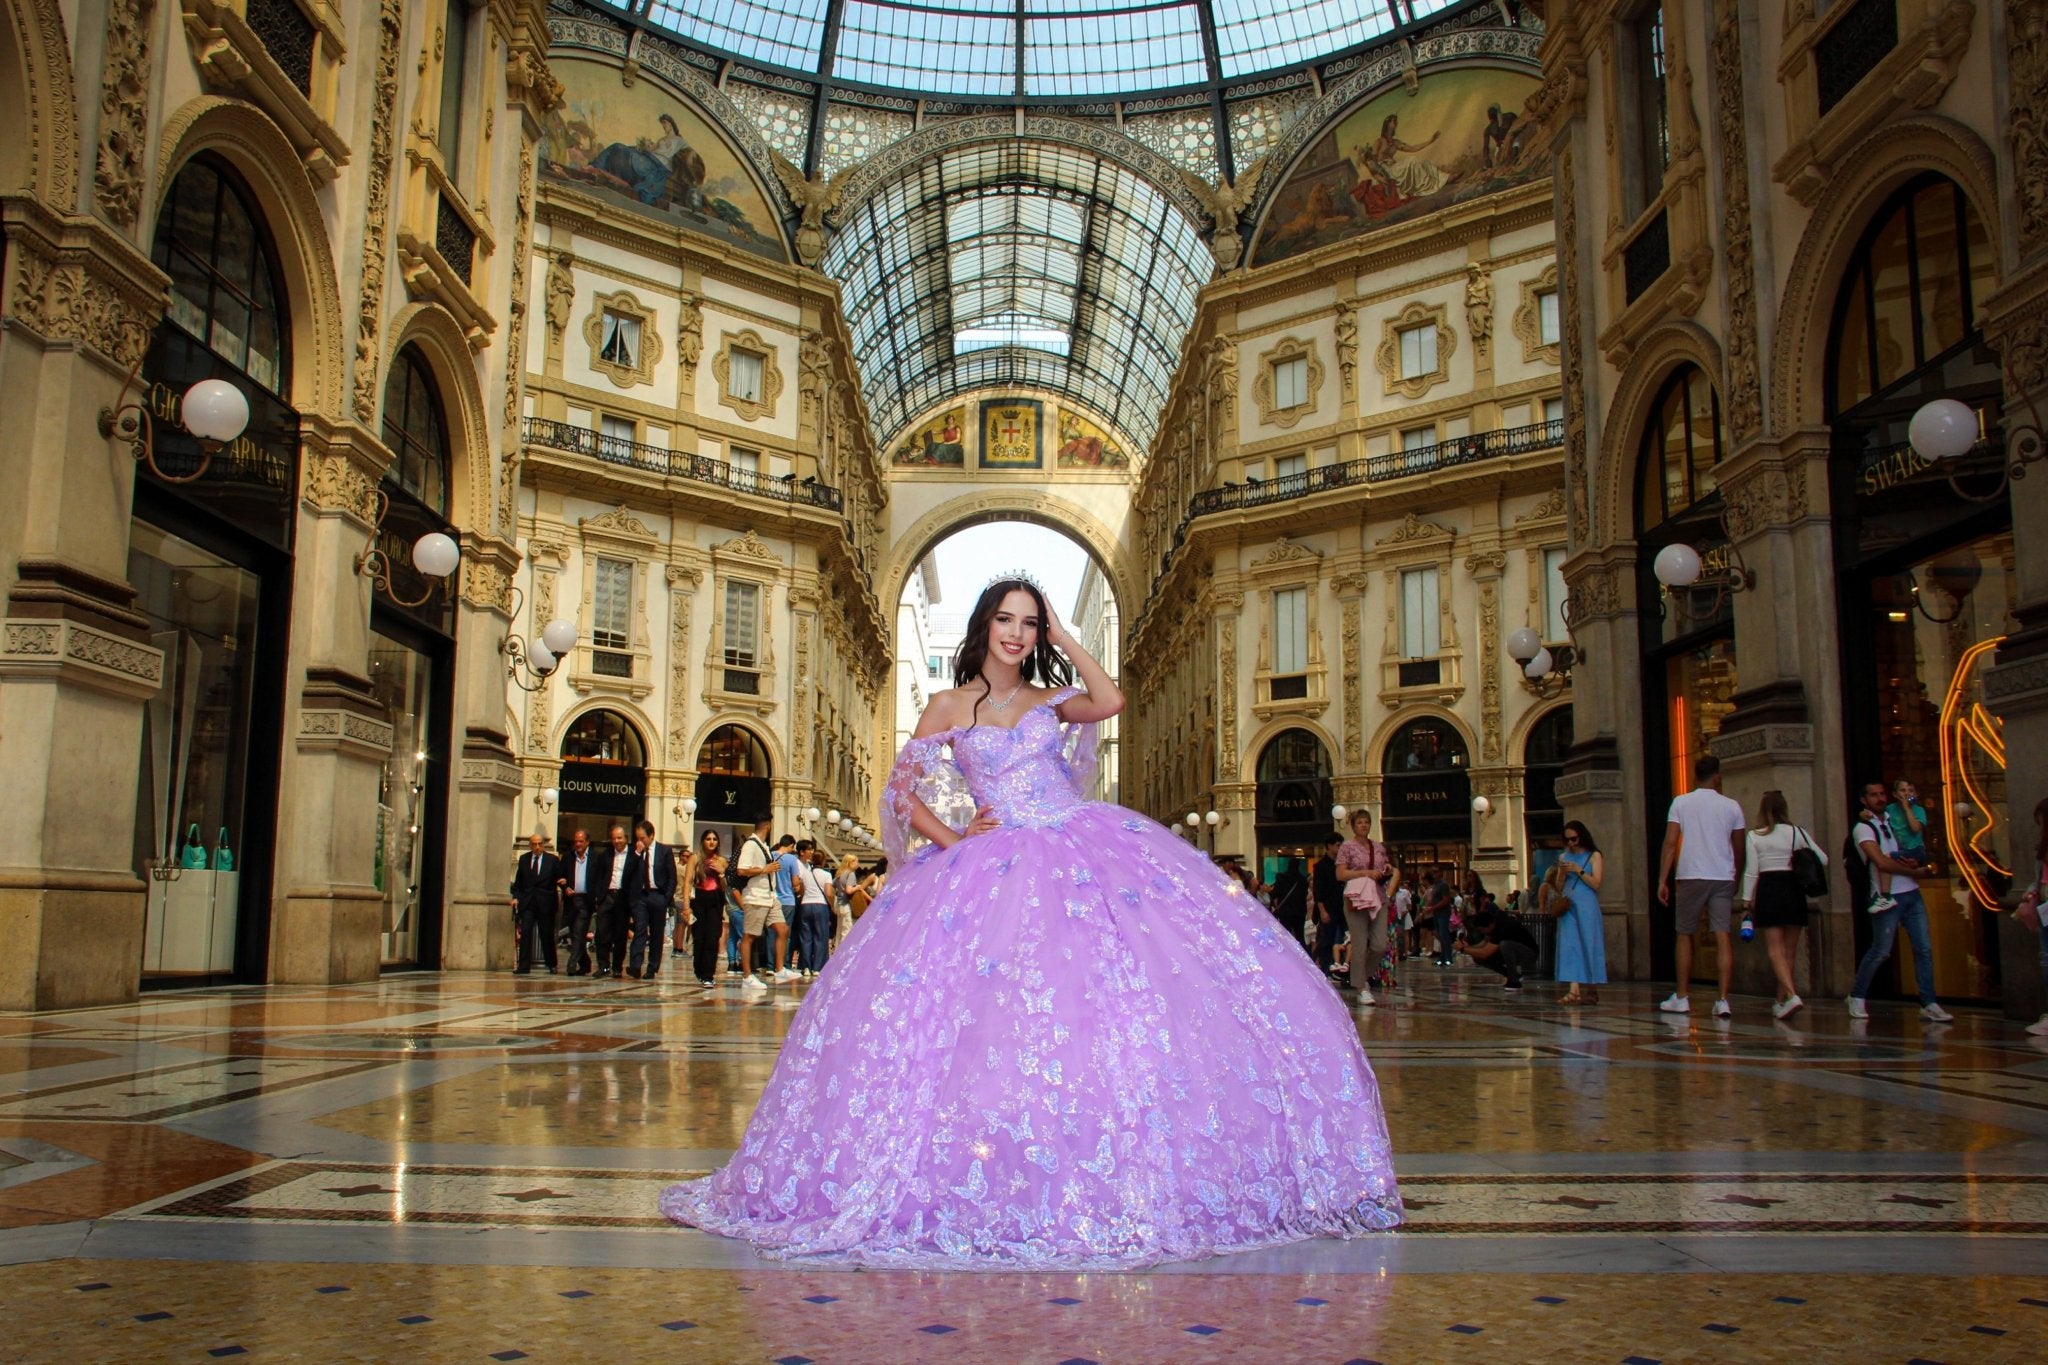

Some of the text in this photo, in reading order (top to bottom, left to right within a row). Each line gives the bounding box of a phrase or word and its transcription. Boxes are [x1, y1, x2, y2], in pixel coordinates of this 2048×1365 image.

[563, 780, 637, 795] LOUIS VUITTON
[1406, 791, 1448, 801] PRADA
[1277, 799, 1314, 808] PRADA
